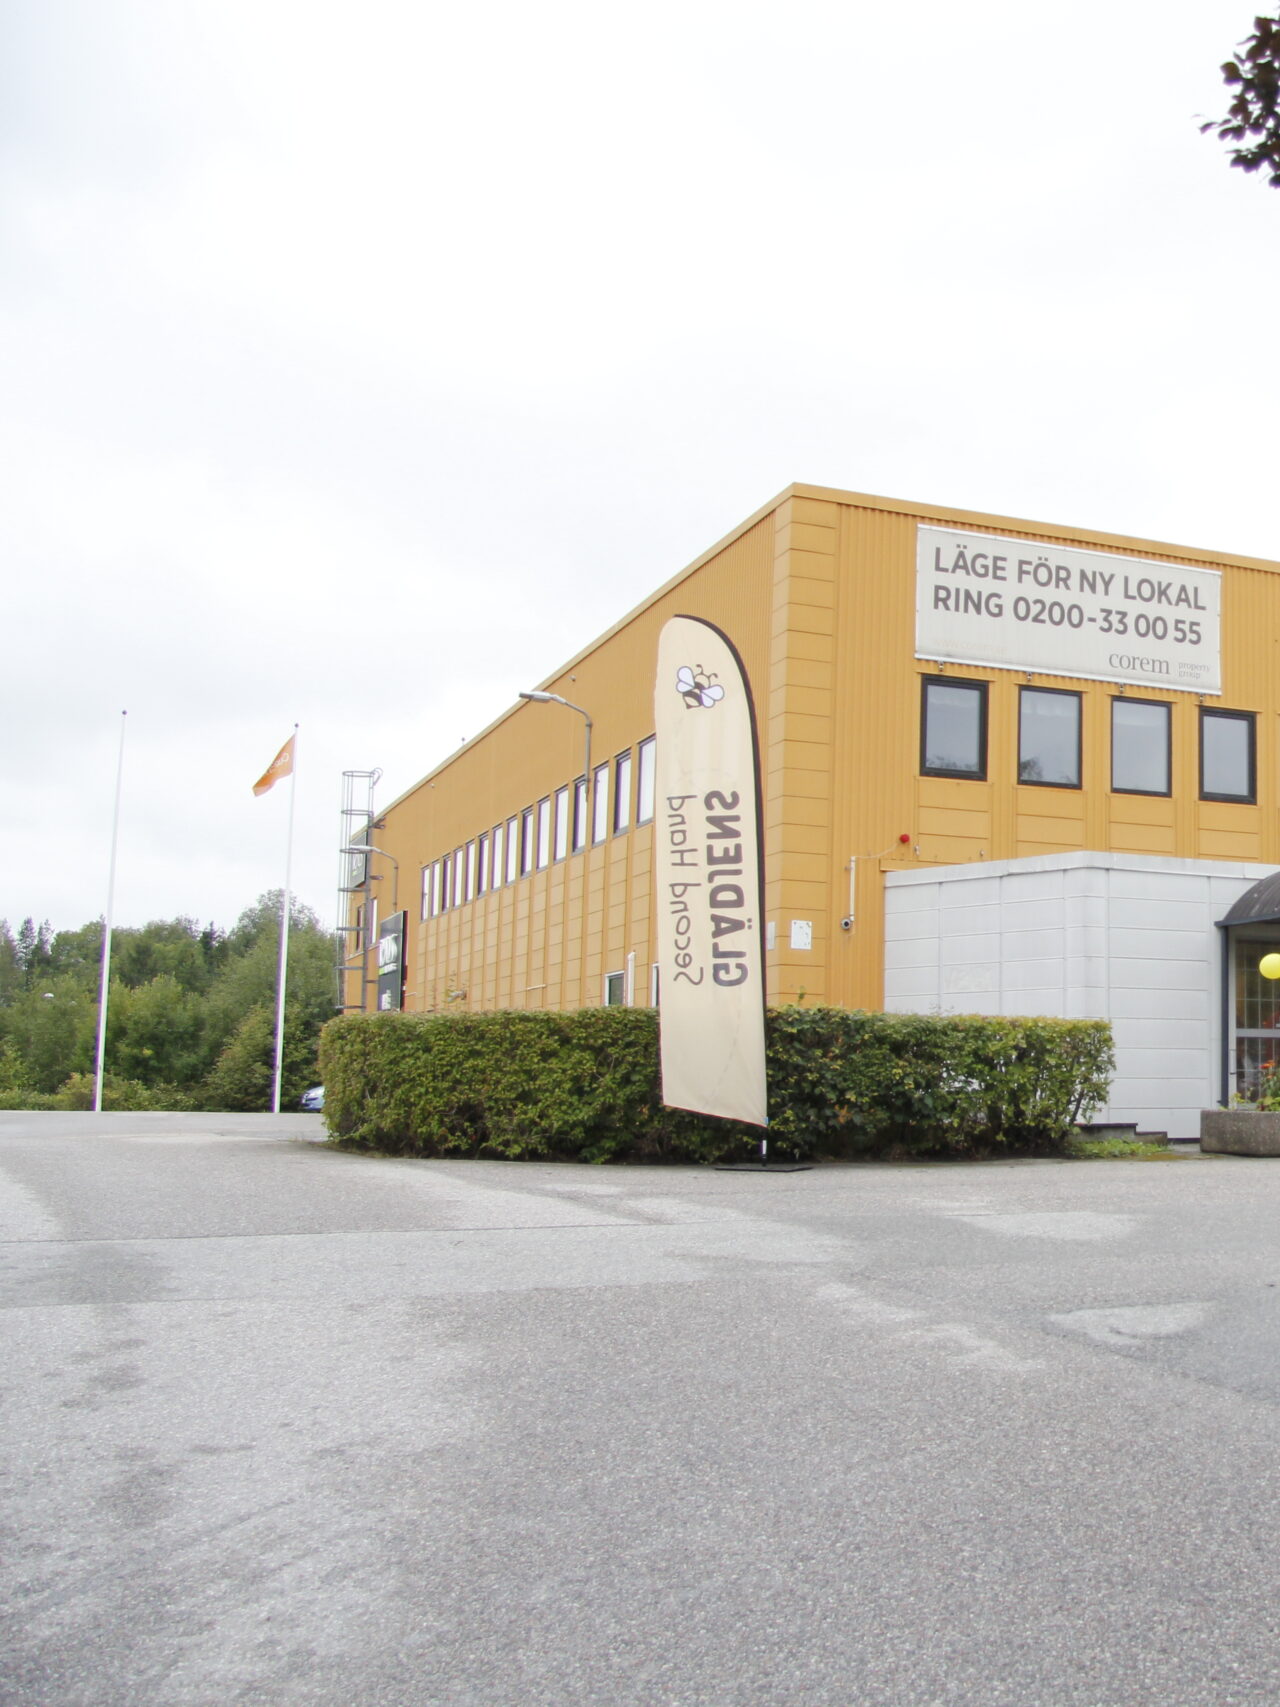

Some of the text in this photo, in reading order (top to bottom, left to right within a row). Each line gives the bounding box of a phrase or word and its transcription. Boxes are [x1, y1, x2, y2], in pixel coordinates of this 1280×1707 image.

[934, 544, 1207, 610] LÄGE FÖR NY LOKAL
[933, 585, 1003, 618] RING
[1134, 613, 1168, 640] 00
[1174, 619, 1202, 645] 55
[1109, 653, 1170, 675] corem
